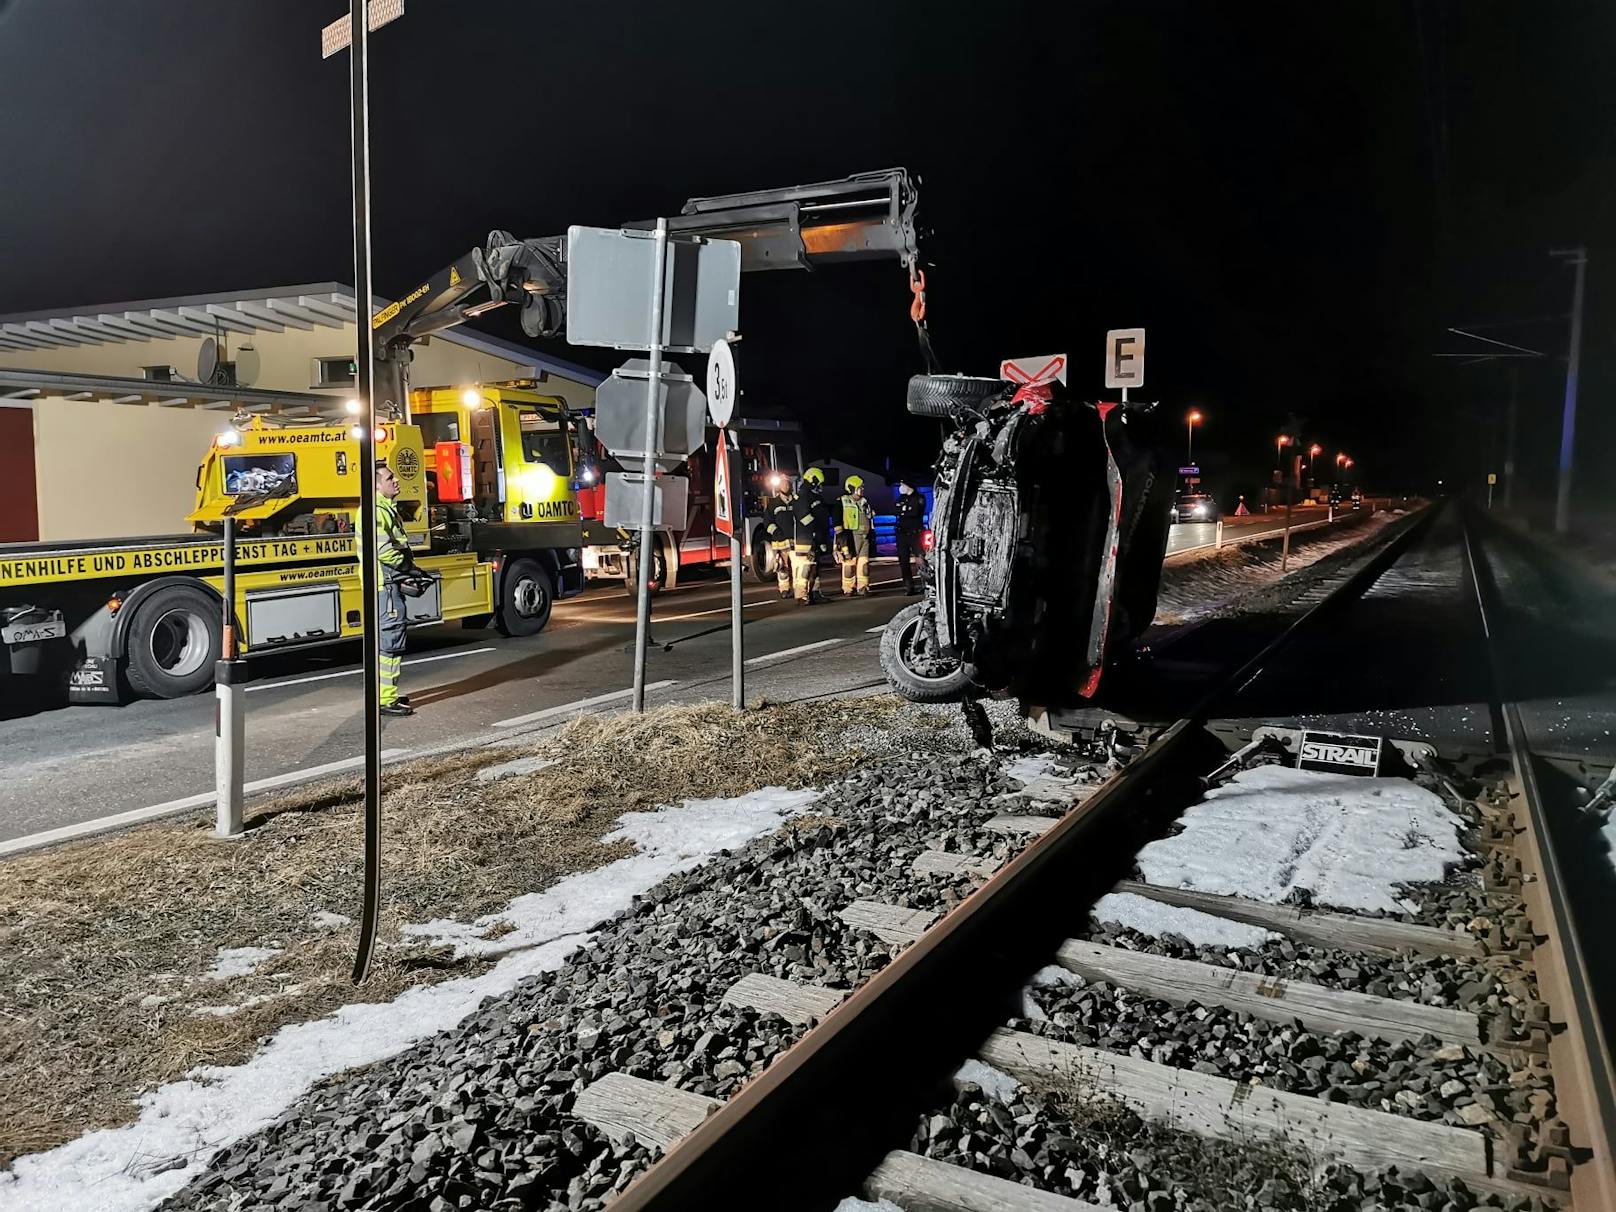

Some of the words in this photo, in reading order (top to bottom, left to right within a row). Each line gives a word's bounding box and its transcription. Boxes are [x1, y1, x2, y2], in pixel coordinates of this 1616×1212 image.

[1114, 337, 1136, 379] E
[258, 430, 347, 444] www.oeamtc.at
[94, 555, 125, 572] UND
[273, 543, 297, 557] TAG
[303, 545, 310, 553] +
[316, 539, 354, 554] NACHT
[280, 565, 355, 582] www.oeamtc.at
[1302, 743, 1378, 766] STRAIL
